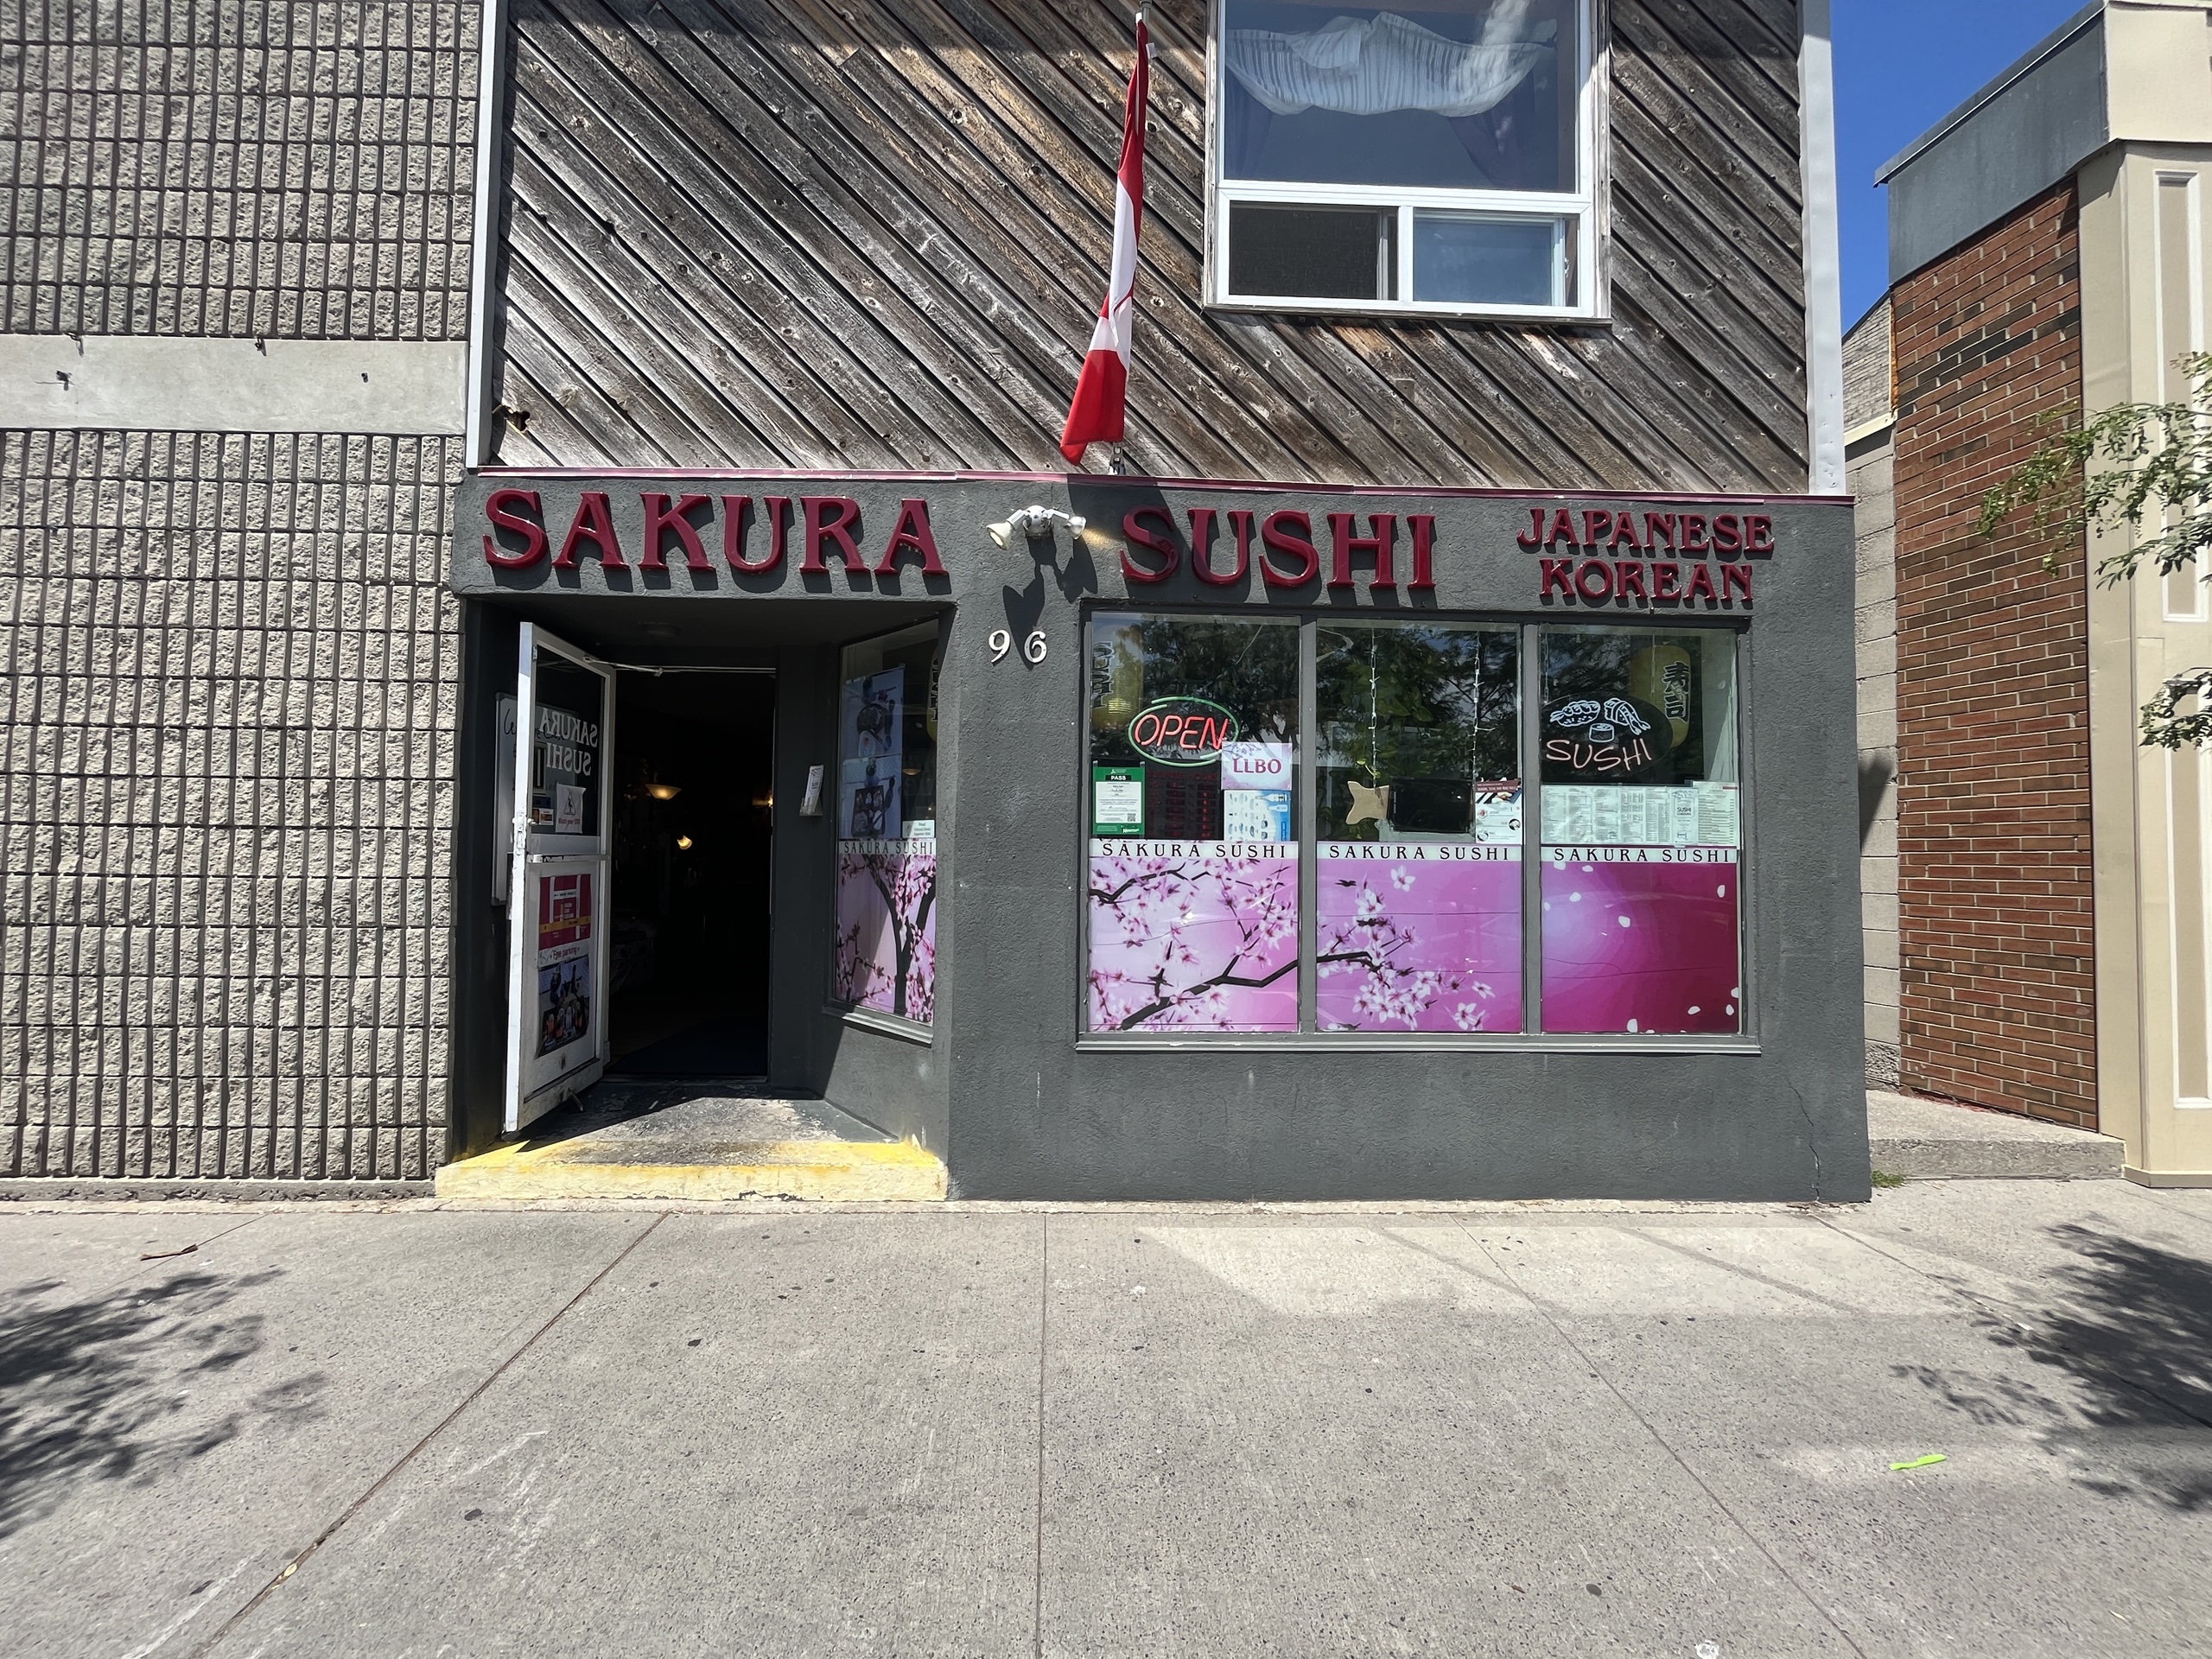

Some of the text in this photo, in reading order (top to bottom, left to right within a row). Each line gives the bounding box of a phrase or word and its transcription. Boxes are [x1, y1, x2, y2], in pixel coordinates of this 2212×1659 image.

[482, 489, 1437, 588] SAKURA SUSHI
[1516, 507, 1775, 552] JAPANESE
[1539, 558, 1753, 601] KOREAN
[988, 629, 1047, 664] 96
[1135, 714, 1230, 750] OPEN
[1233, 758, 1282, 774] LLBO
[1546, 738, 1651, 771] SUSHI
[844, 842, 932, 855] SAKURA SUSHI
[1102, 843, 1286, 858] SAKURA SUSHI
[1329, 845, 1509, 861] SAKURA SUSHI
[1554, 848, 1729, 862] SAKURA SUSHI
